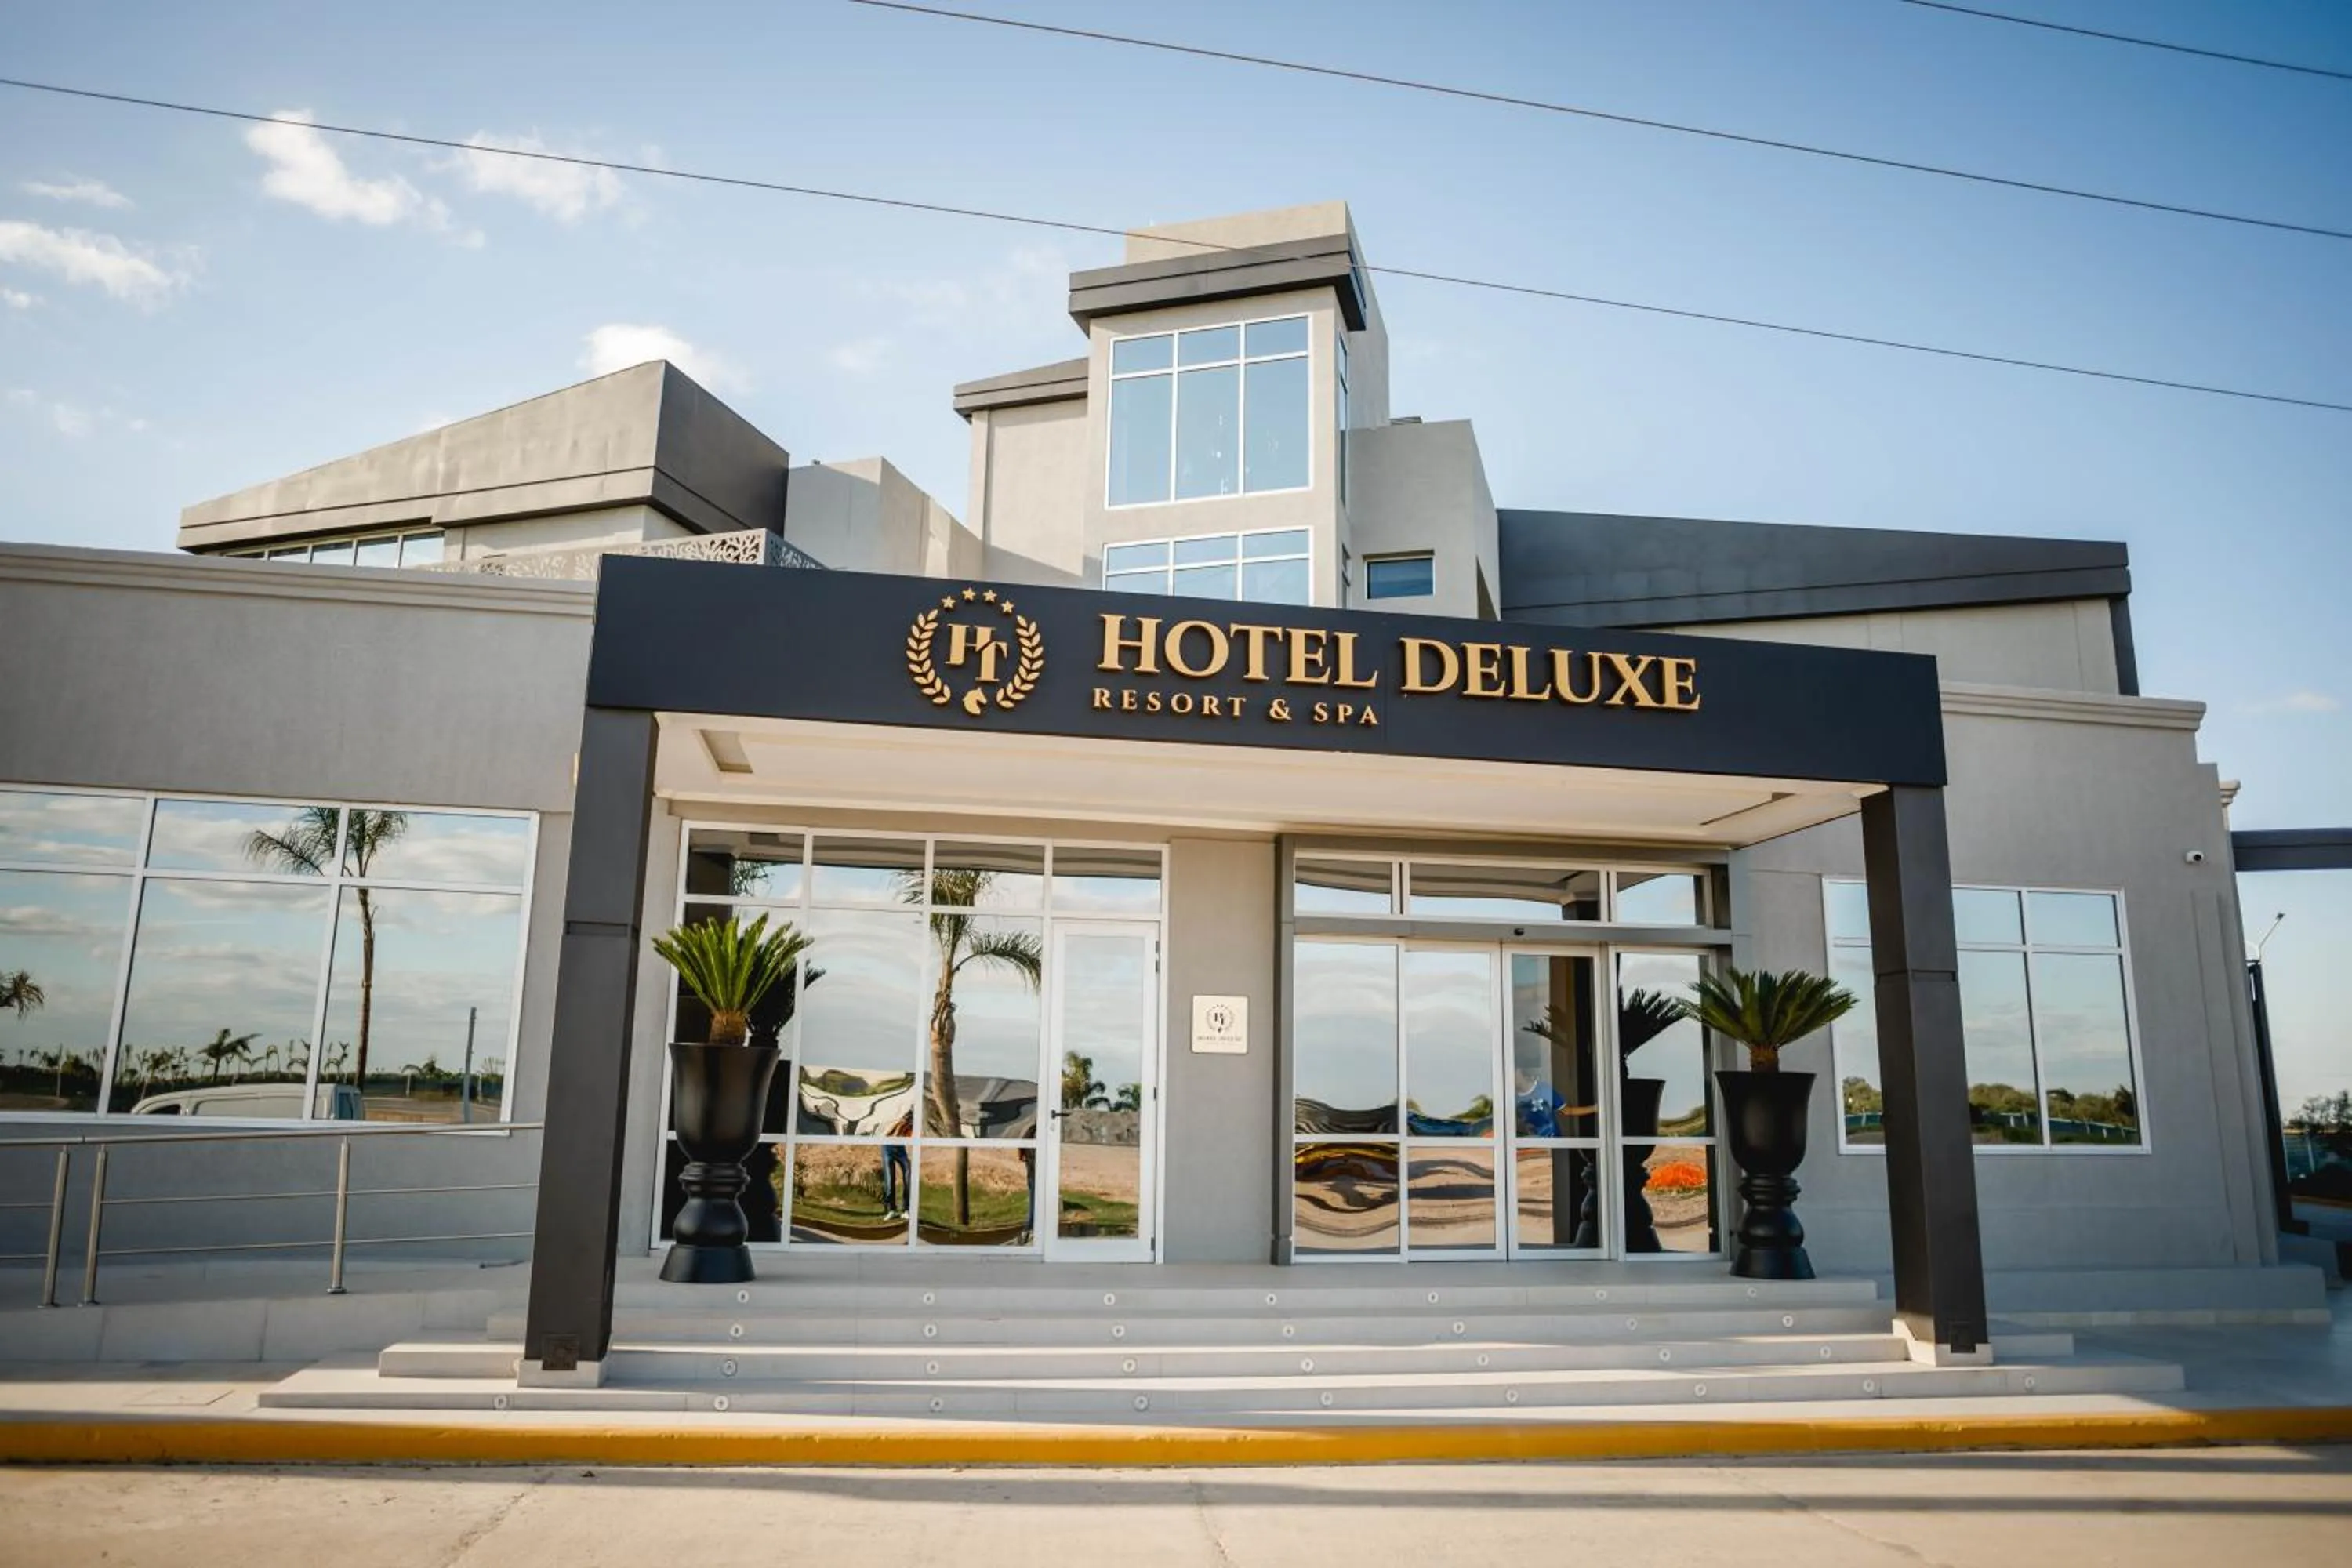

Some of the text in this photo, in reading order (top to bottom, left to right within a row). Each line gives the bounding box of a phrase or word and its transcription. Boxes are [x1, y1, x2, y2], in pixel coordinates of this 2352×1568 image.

[1098, 614, 1700, 710] HOTEL DELUXE
[1093, 688, 1377, 724] RESORT & SPA
